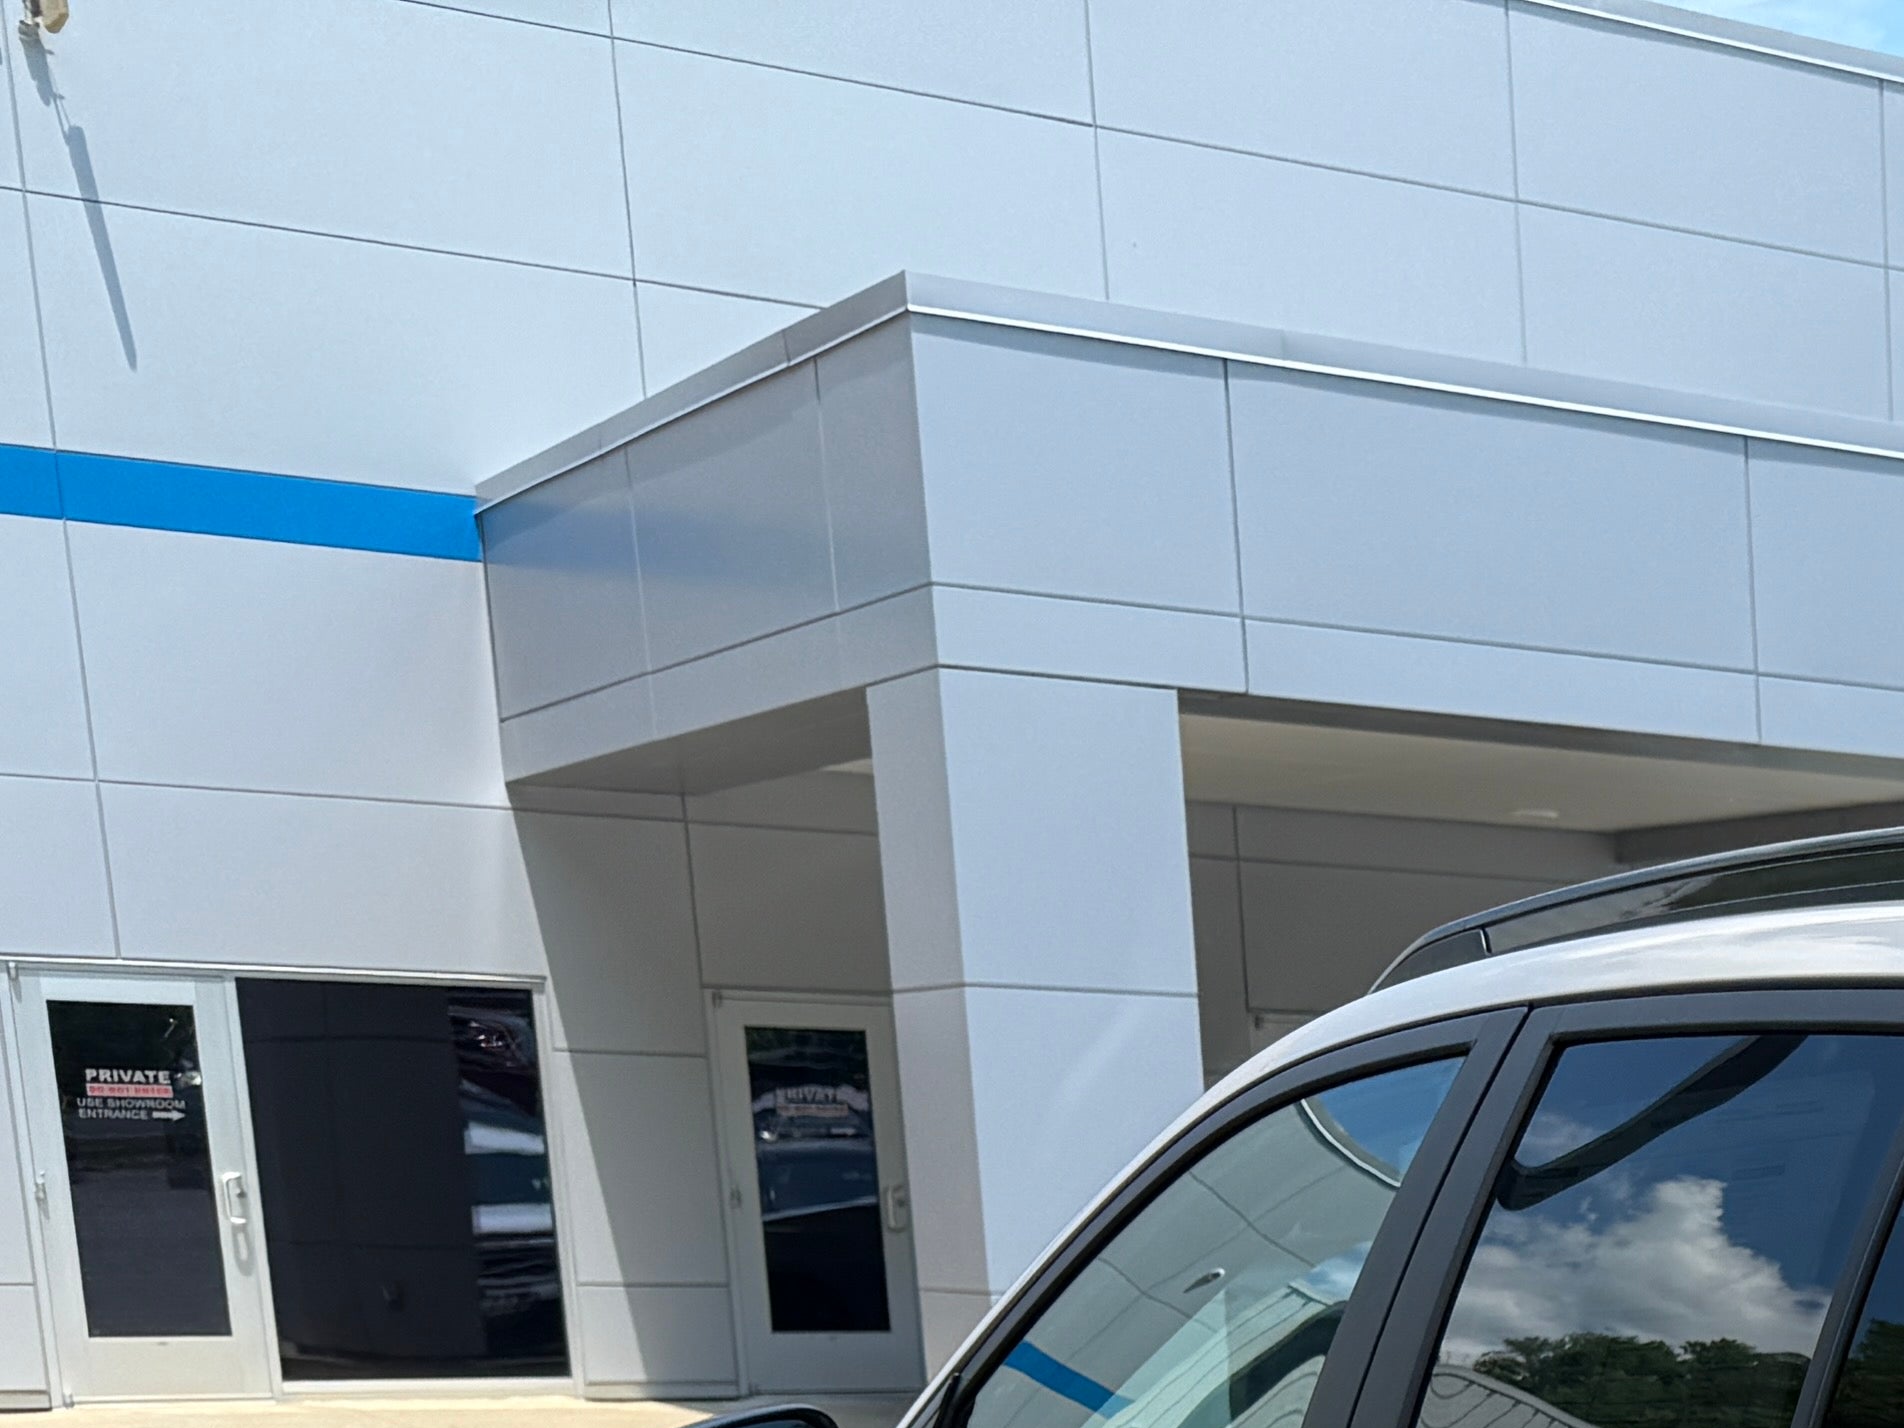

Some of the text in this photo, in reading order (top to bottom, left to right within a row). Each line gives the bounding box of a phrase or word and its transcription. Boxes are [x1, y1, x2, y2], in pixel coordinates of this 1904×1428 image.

[85, 1068, 171, 1084] PRIVATE
[76, 1097, 186, 1110] USE SHOWROOM
[78, 1108, 149, 1120] ENTRANCE
